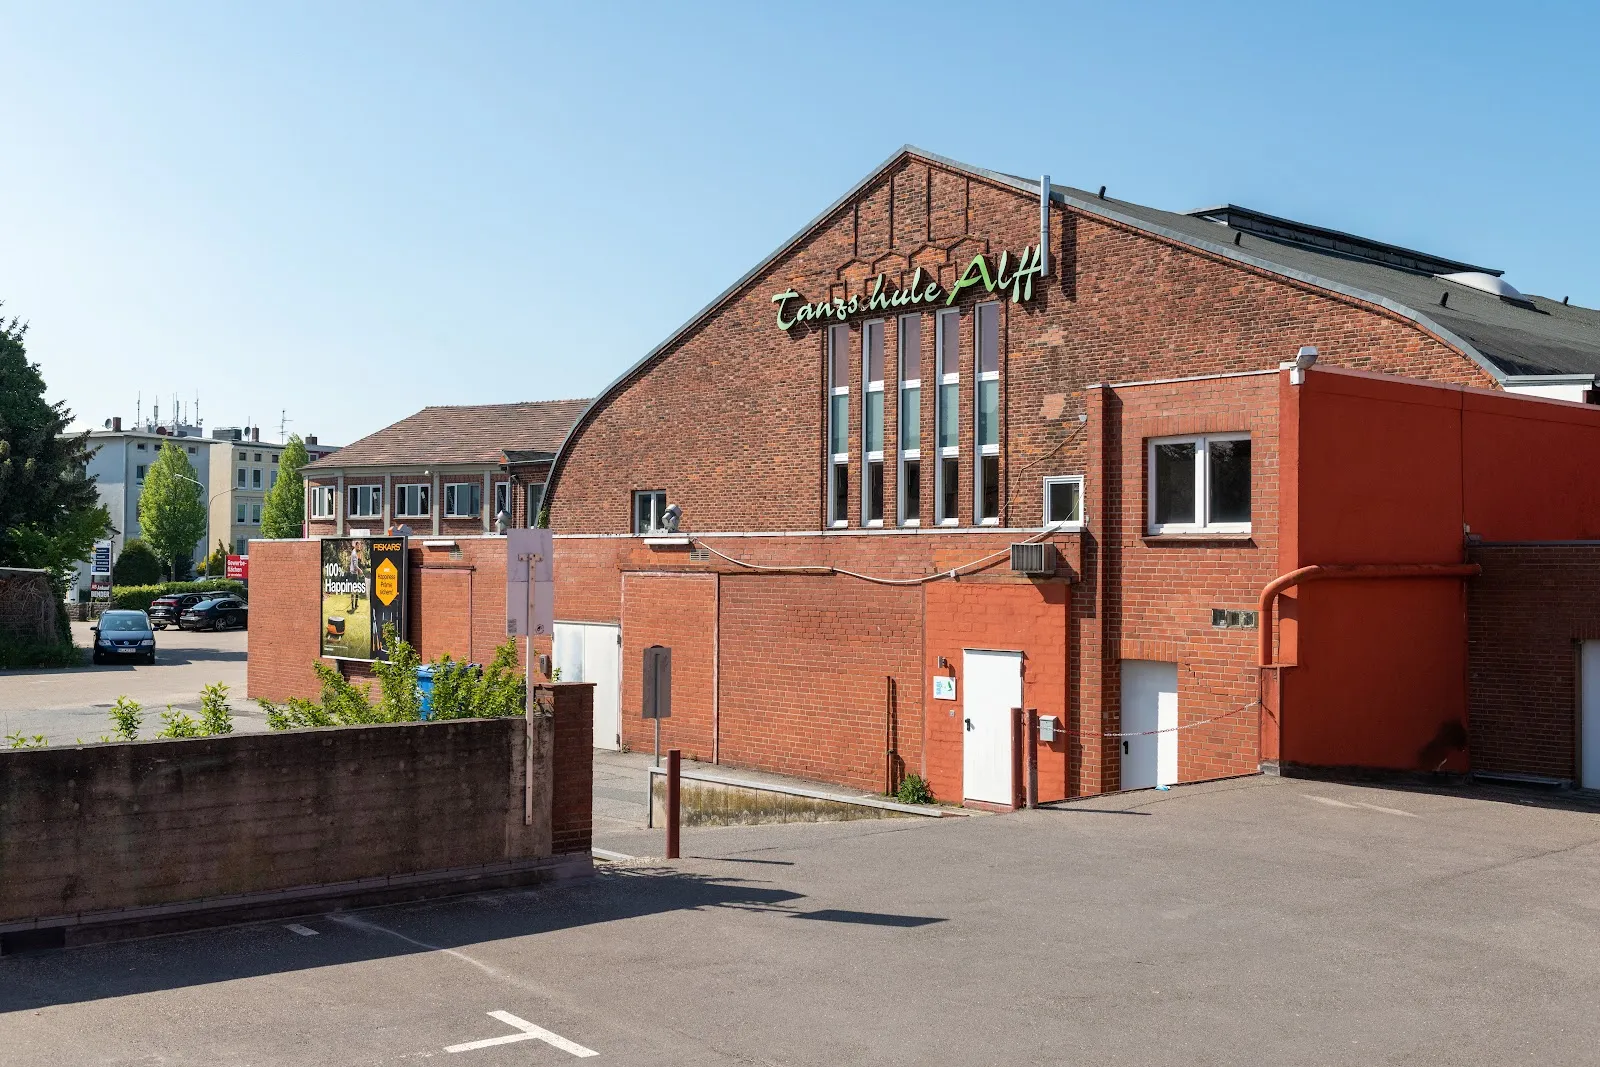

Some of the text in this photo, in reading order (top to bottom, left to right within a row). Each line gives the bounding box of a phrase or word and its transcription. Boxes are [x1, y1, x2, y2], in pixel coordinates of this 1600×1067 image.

[945, 243, 1042, 306] Alff
[373, 543, 400, 551] FISKARS
[325, 563, 345, 577] 100%
[325, 579, 366, 595] Happiness
